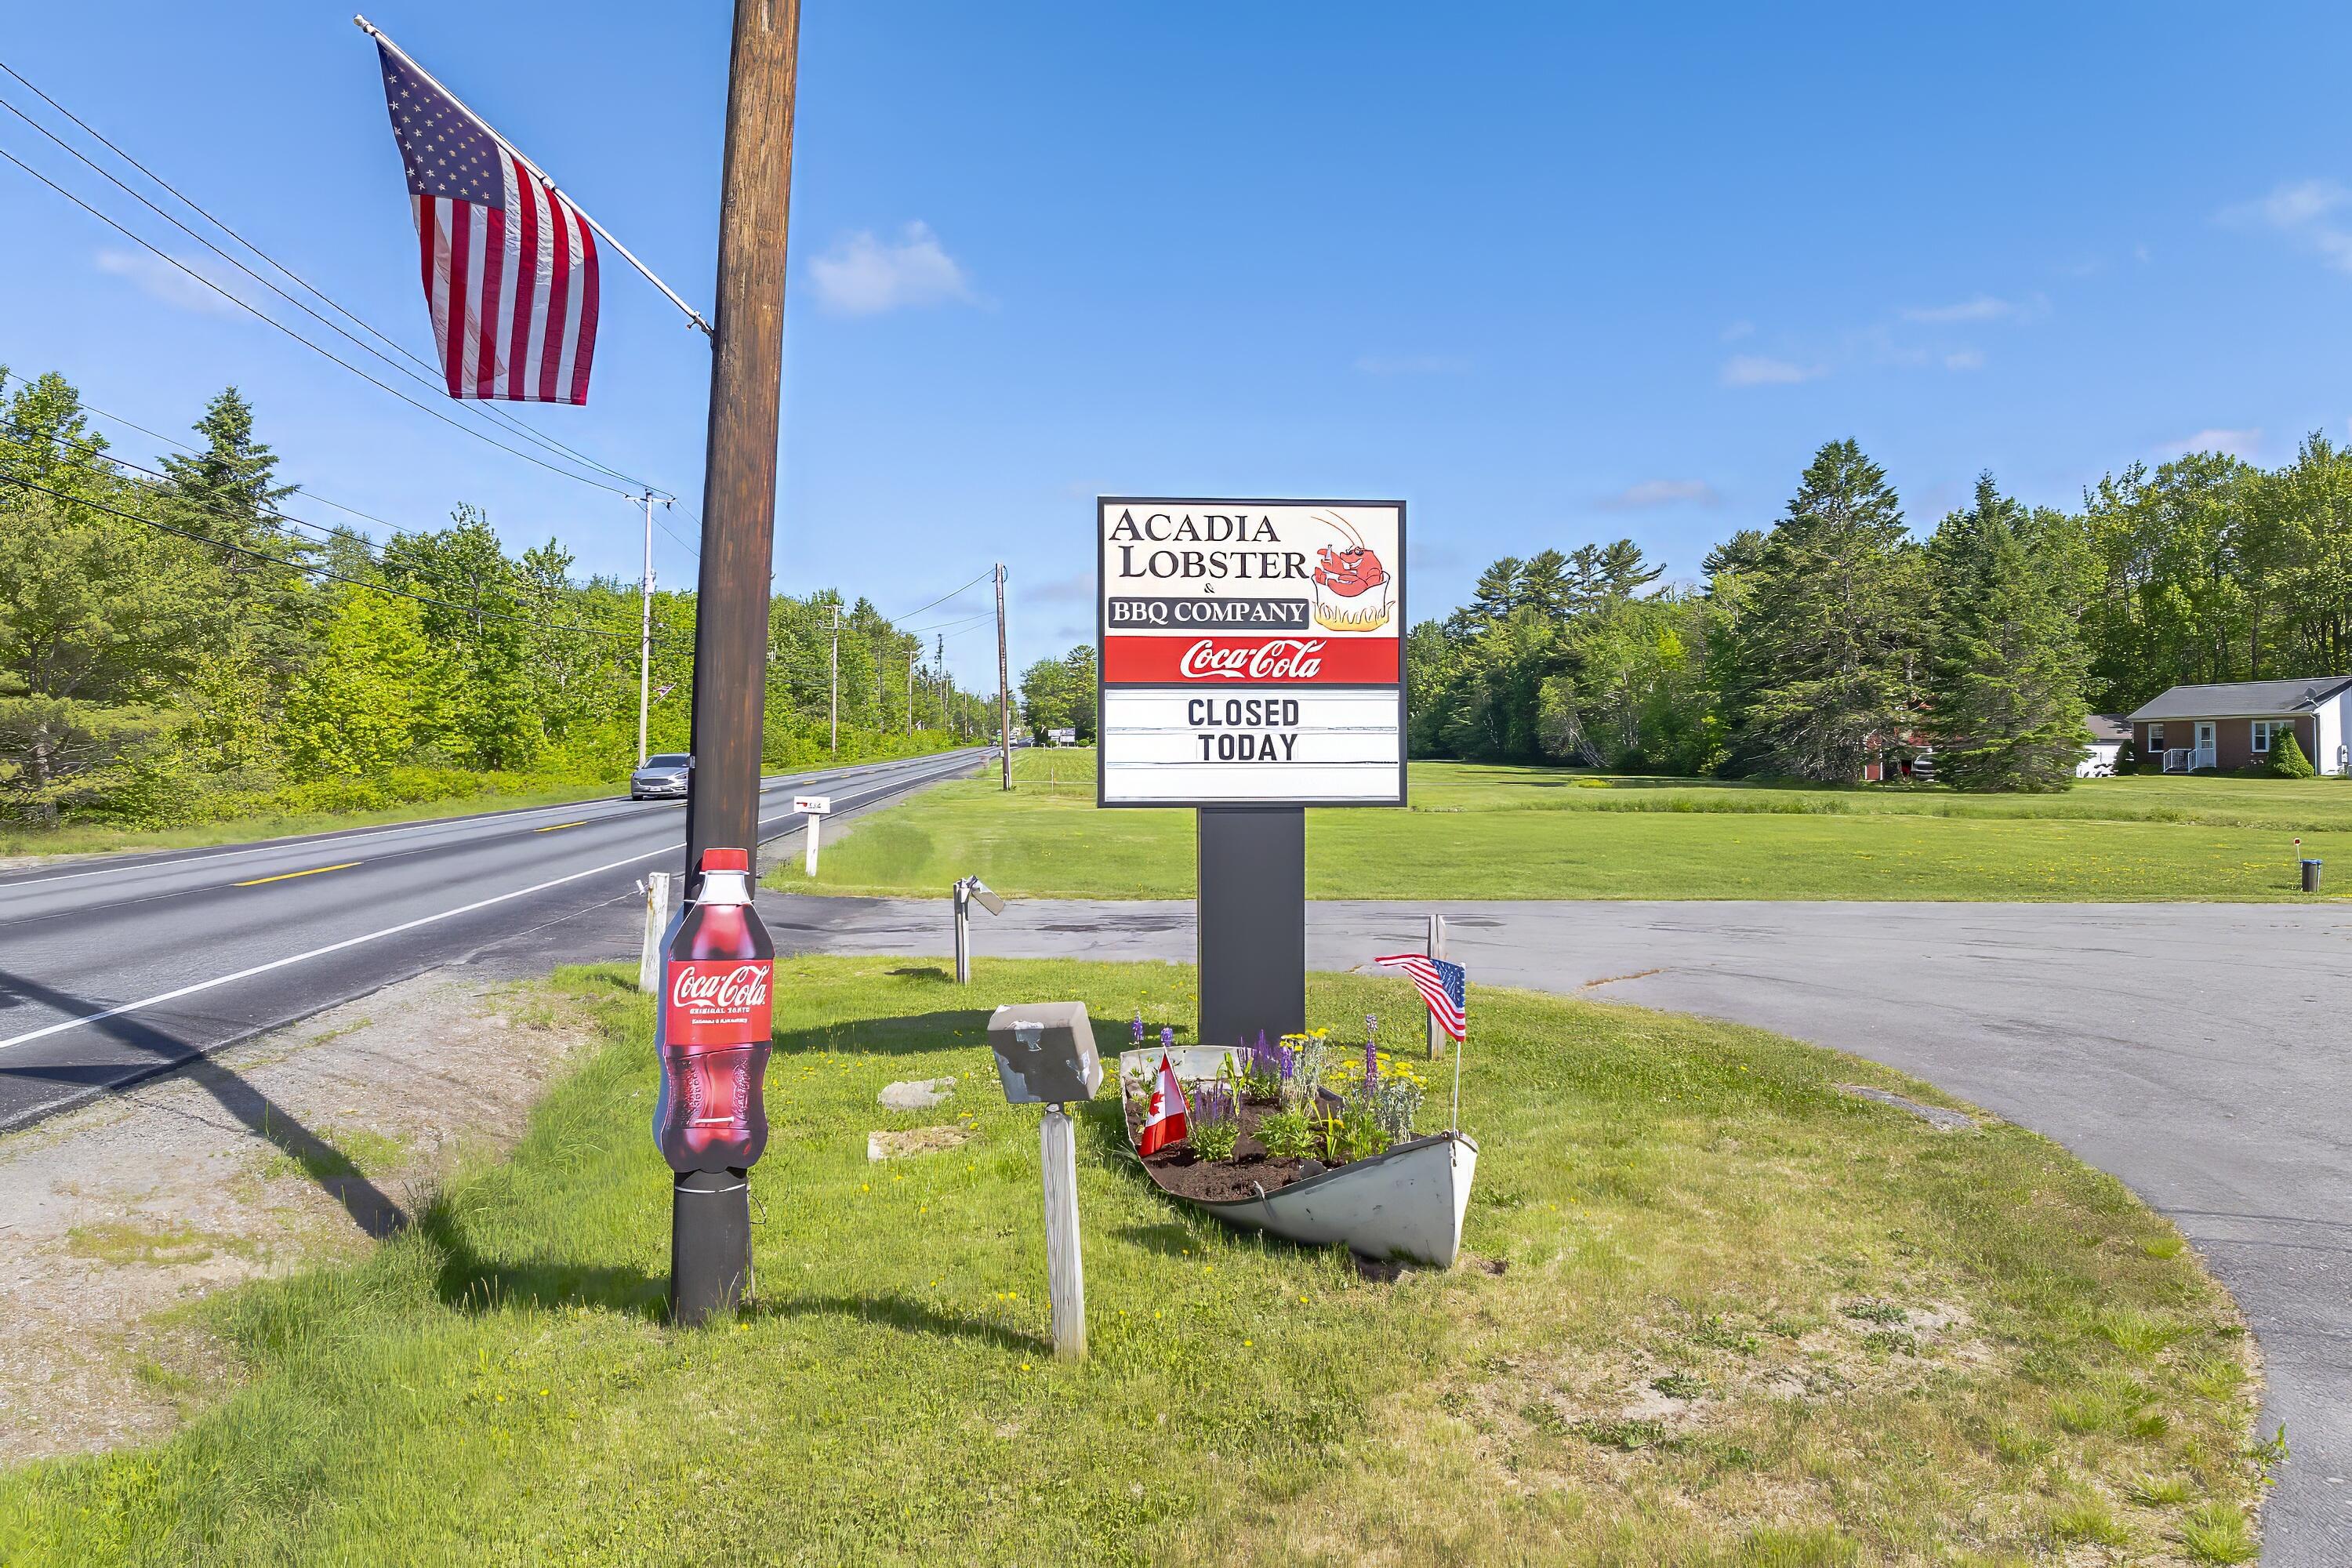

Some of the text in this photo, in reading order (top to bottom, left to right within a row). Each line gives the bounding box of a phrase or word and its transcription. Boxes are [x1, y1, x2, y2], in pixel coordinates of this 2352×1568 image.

[1108, 508, 1281, 543] ACADIA
[1118, 545, 1310, 579] LOBSTER
[1203, 583, 1215, 593] &
[1112, 601, 1306, 626] BBQ COMPANY
[1180, 639, 1327, 678] Coca-Cola
[1188, 699, 1299, 726] CLOSED
[1198, 734, 1298, 761] TODAY
[673, 965, 770, 1007] Coca-Cola
